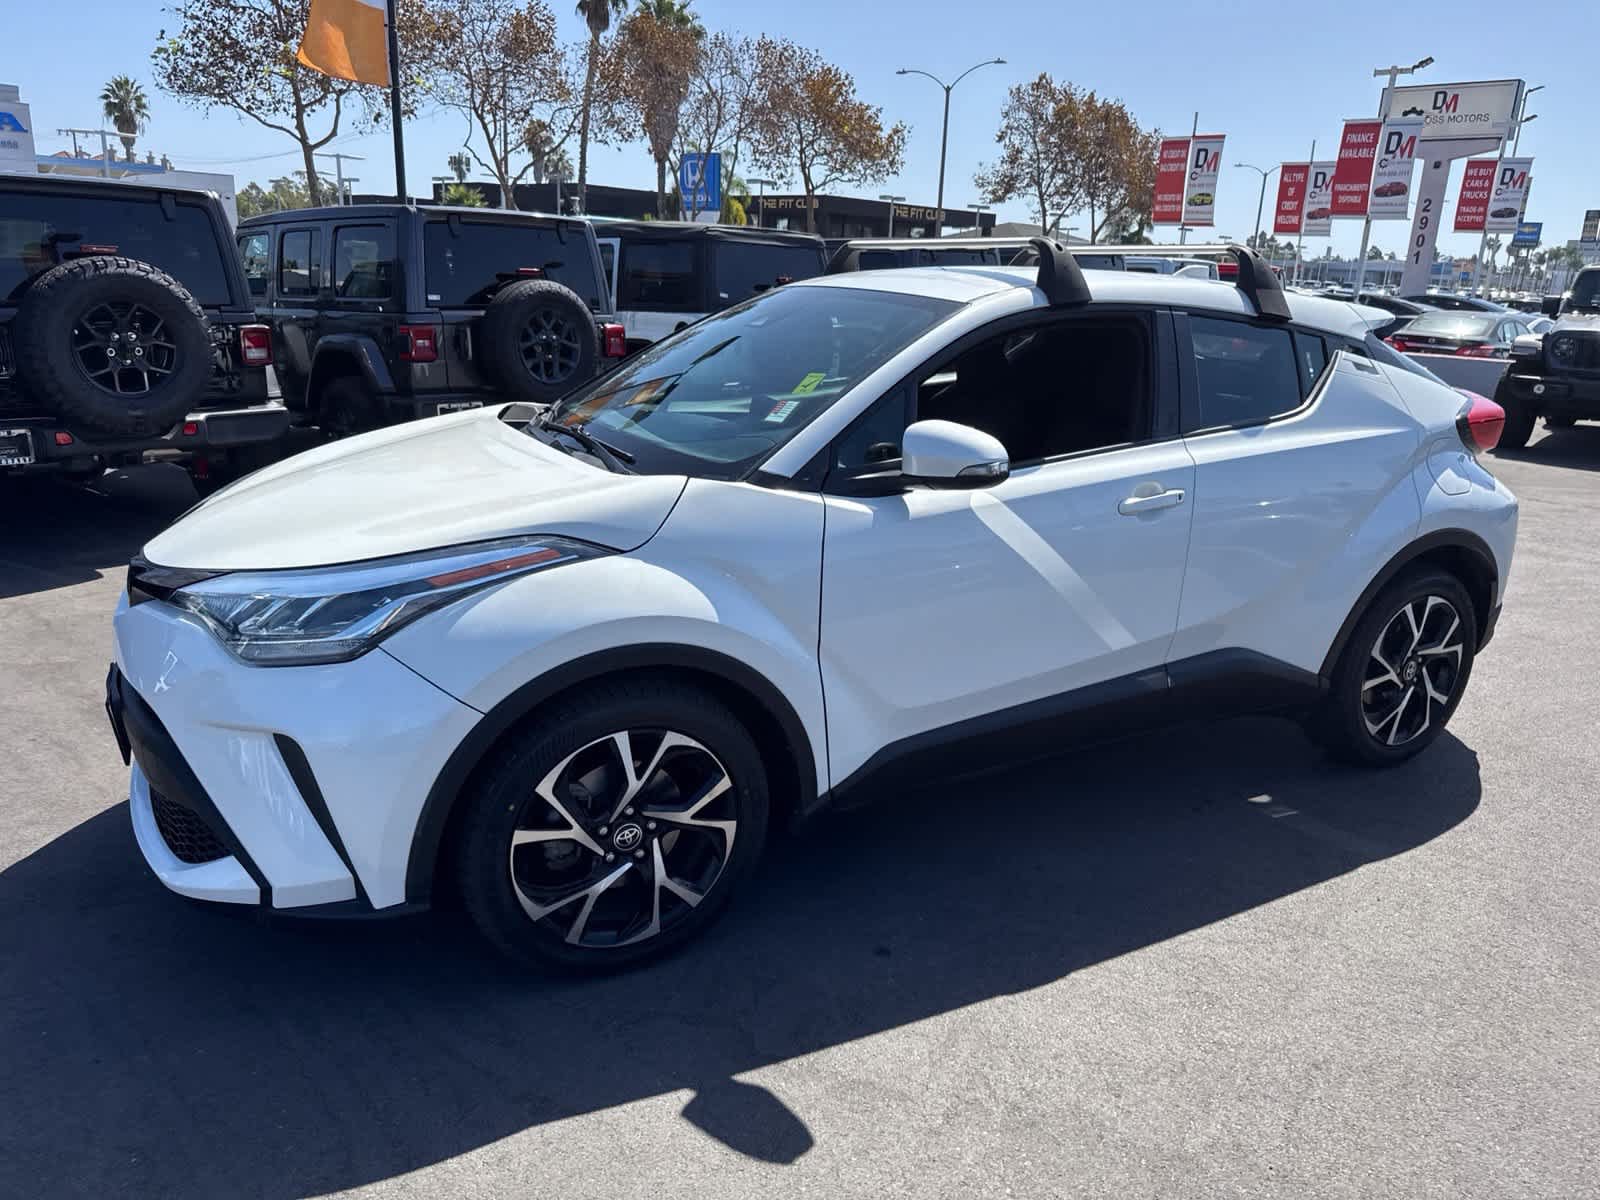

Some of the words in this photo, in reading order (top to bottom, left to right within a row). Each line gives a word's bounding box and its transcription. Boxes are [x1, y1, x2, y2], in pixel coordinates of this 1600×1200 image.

[1432, 91, 1460, 114] DM
[1423, 113, 1445, 125] OSS
[1447, 113, 1490, 124] MOTORS
[1346, 132, 1375, 143] FINANCE
[1384, 131, 1417, 159] DM
[1340, 146, 1376, 159] AVAILABLE
[1195, 148, 1220, 173] DM
[1467, 167, 1479, 177] WE
[1479, 167, 1495, 177] BUY
[1500, 167, 1527, 189] DM
[1465, 179, 1483, 188] CARS
[1462, 190, 1488, 199] TRUCKS
[779, 198, 794, 209] FIT
[796, 198, 819, 209] CLB
[910, 207, 925, 219] FIT
[1413, 198, 1432, 265] 2901
